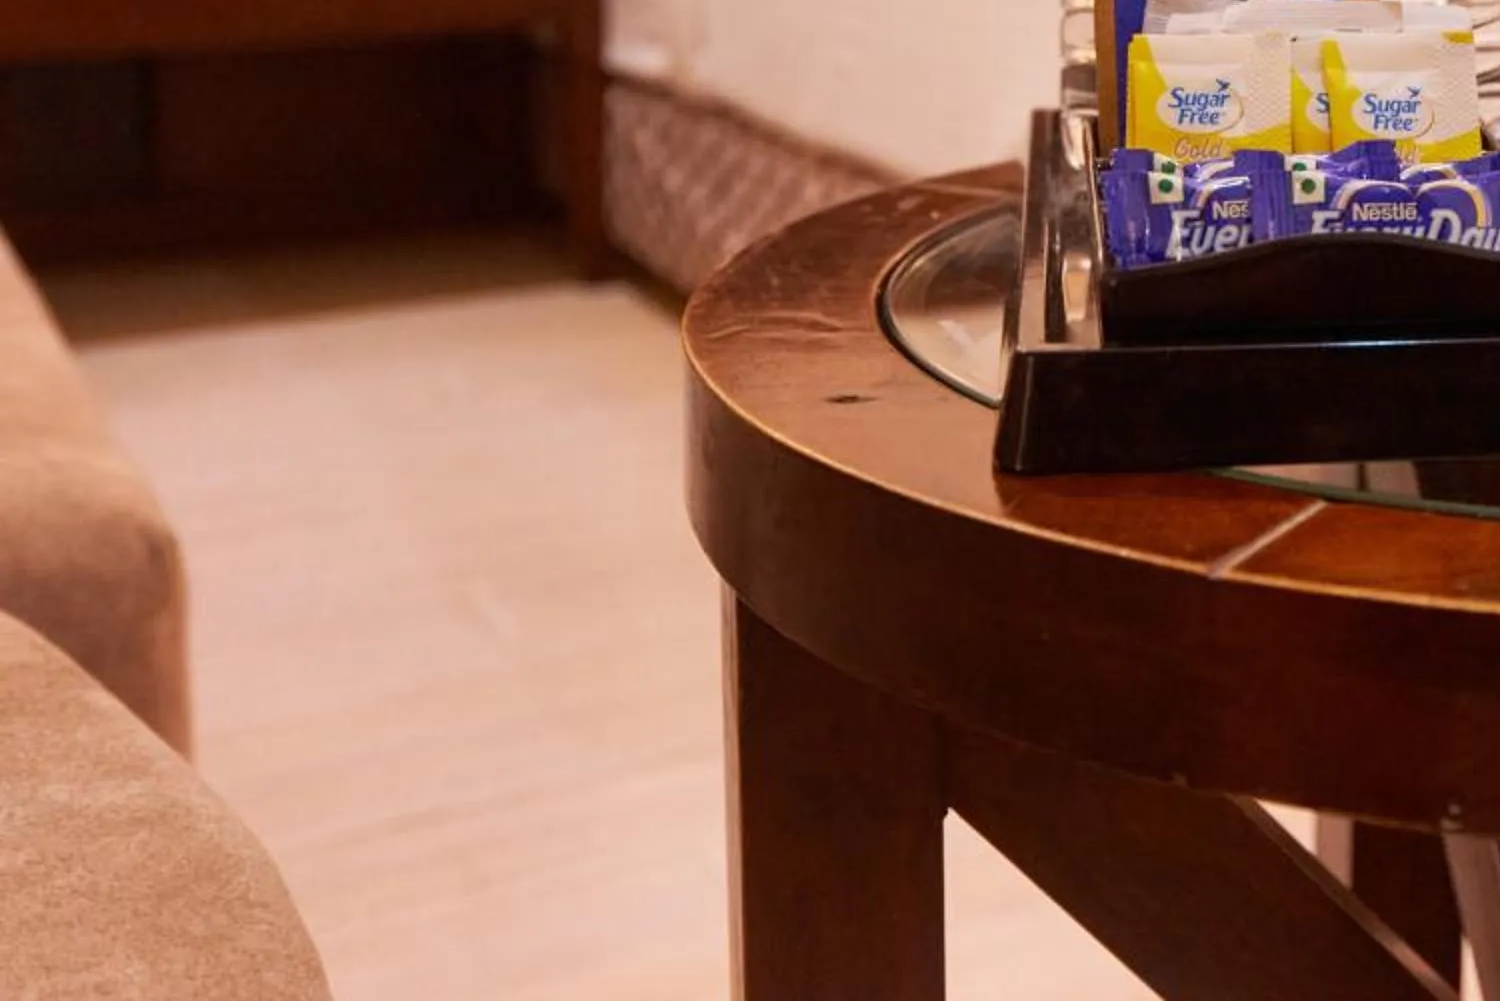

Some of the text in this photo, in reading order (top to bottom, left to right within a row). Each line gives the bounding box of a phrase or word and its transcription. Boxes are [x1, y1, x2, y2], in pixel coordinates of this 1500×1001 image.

[1168, 86, 1231, 117] Sugar
[1362, 93, 1422, 121] Sugar
[1176, 107, 1222, 126] Free
[1371, 113, 1416, 132] Free
[1173, 137, 1226, 160] Gold
